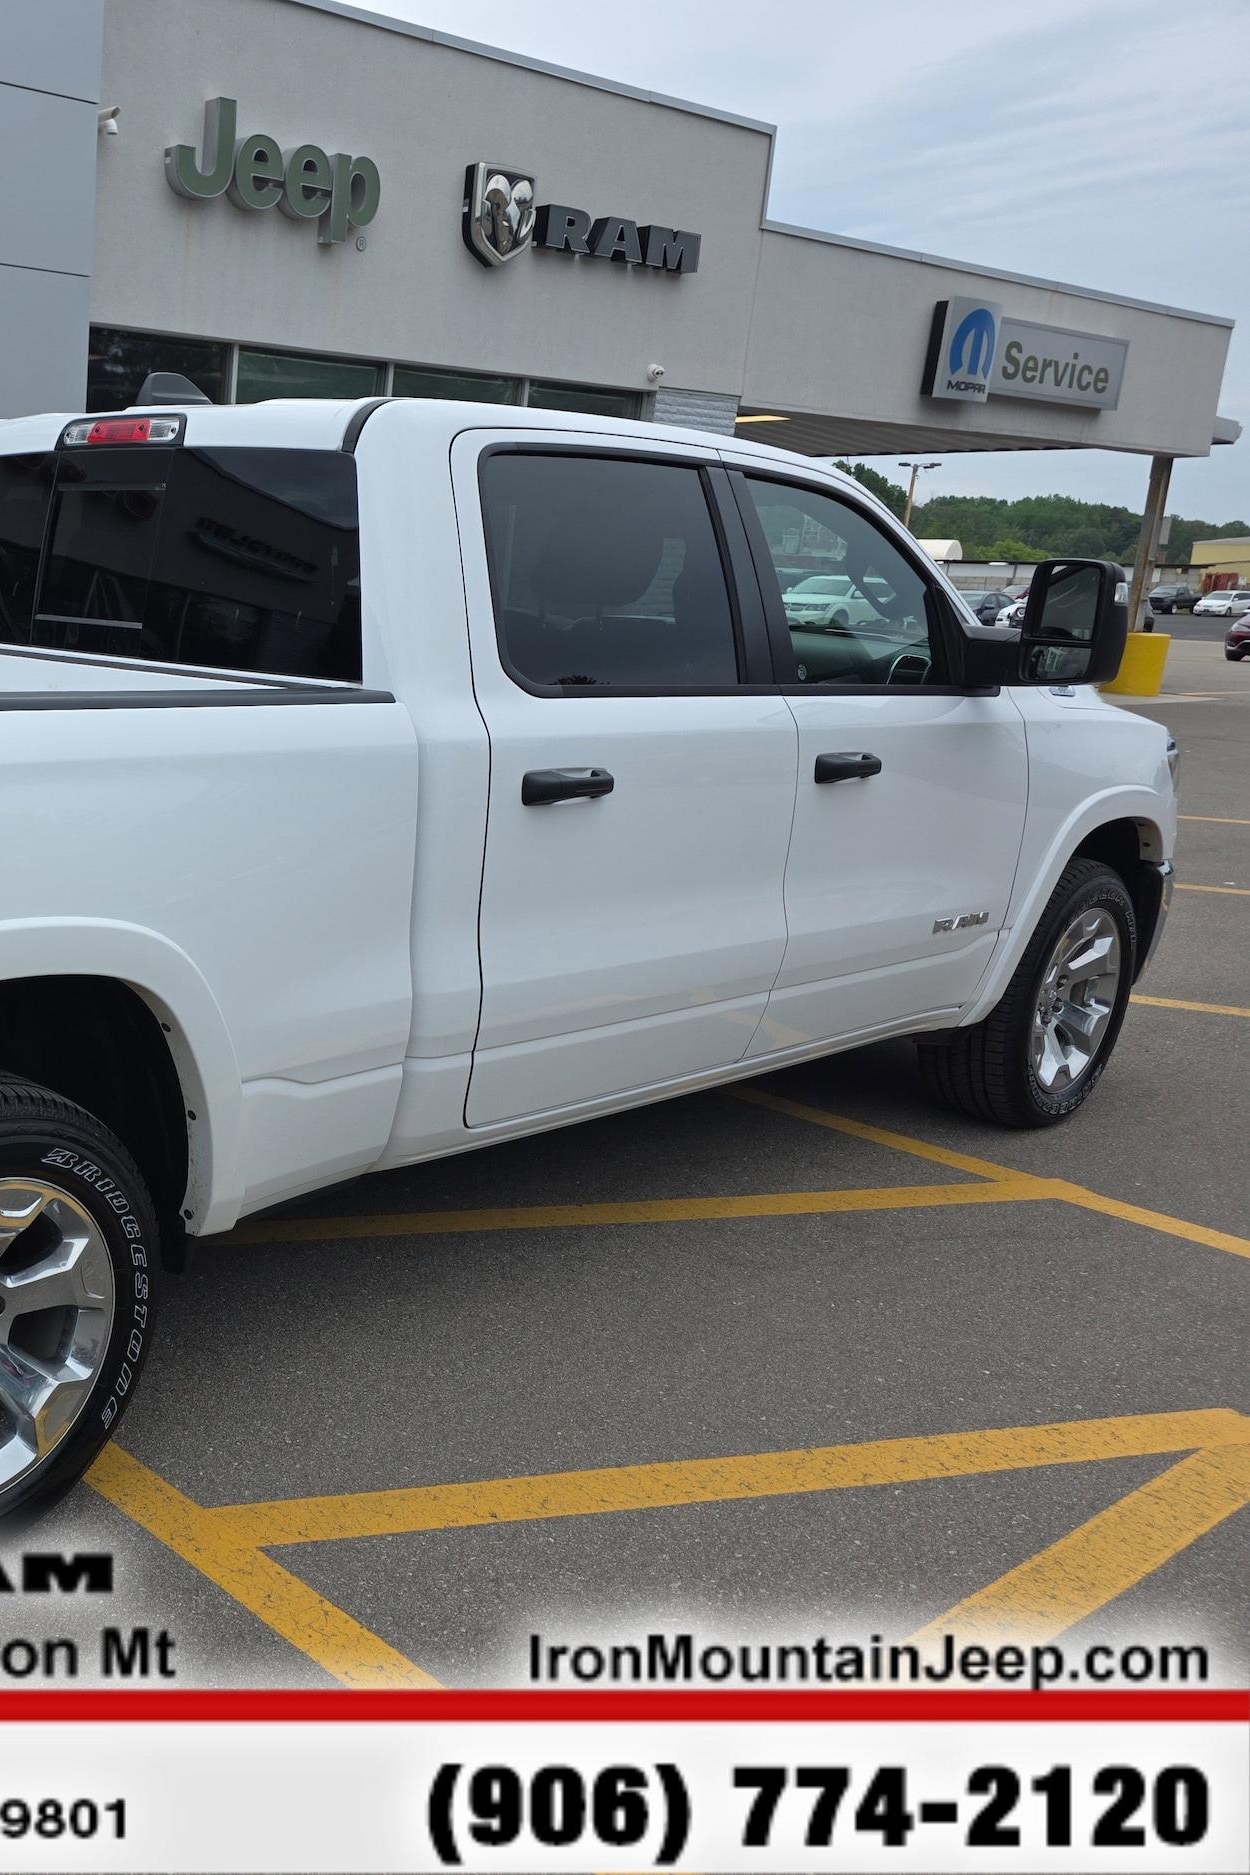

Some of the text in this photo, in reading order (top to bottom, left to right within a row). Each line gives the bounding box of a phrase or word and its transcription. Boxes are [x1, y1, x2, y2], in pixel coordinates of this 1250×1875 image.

[165, 97, 381, 246] Jeep
[535, 203, 702, 274] RAM
[946, 380, 987, 394] MOPAR
[1001, 340, 1110, 394] Service
[932, 911, 989, 934] RAM
[39, 1146, 150, 1431] BRIDGESTONE
